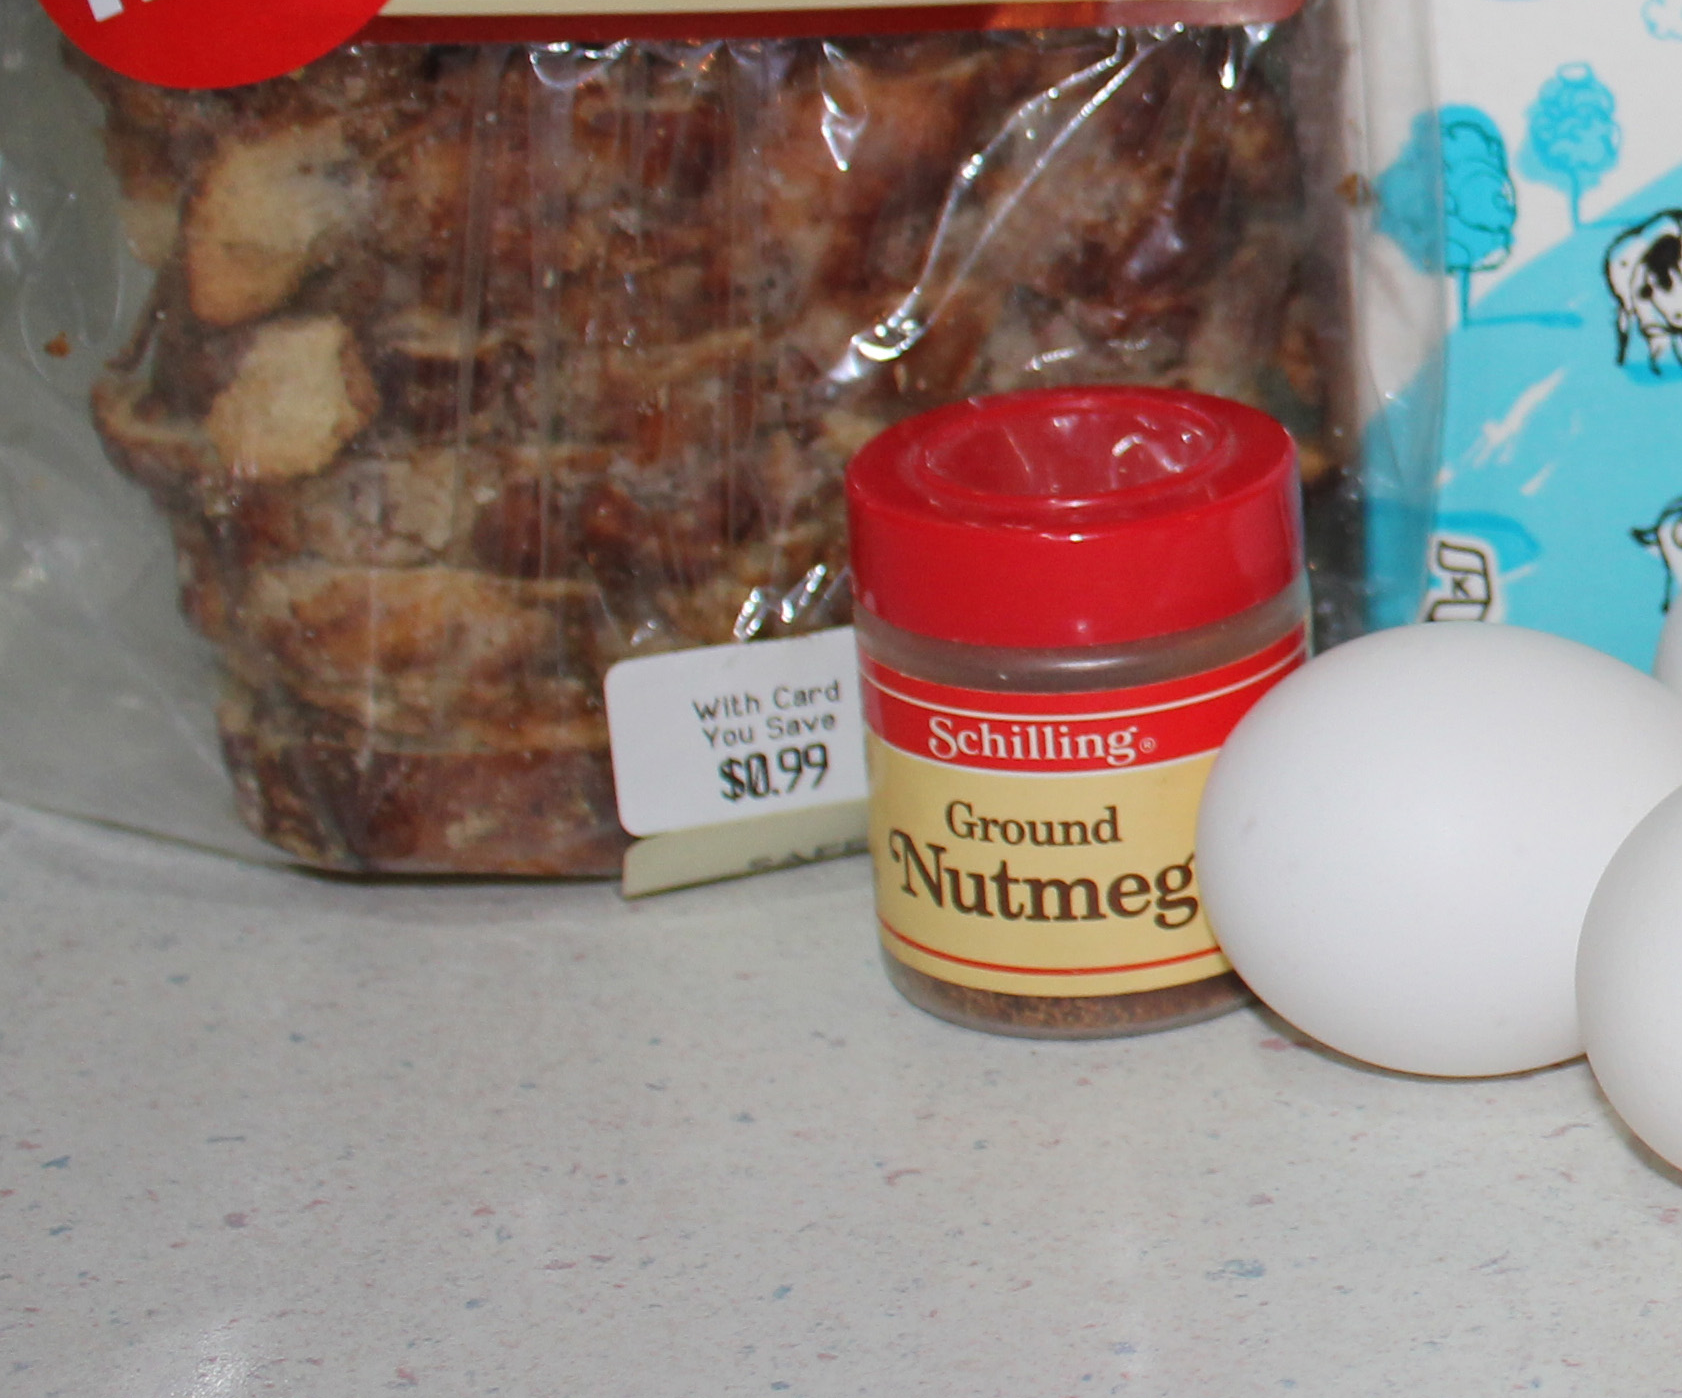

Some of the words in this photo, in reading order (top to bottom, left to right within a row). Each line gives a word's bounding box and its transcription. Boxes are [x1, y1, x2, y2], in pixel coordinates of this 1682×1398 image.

[772, 678, 841, 710] Card
[701, 726, 755, 748] You
[765, 712, 837, 740] Save
[926, 716, 1139, 764] Schilling
[718, 741, 829, 802] $0.99
[945, 800, 1122, 848] Ground
[889, 828, 1199, 931] Nutmeg
